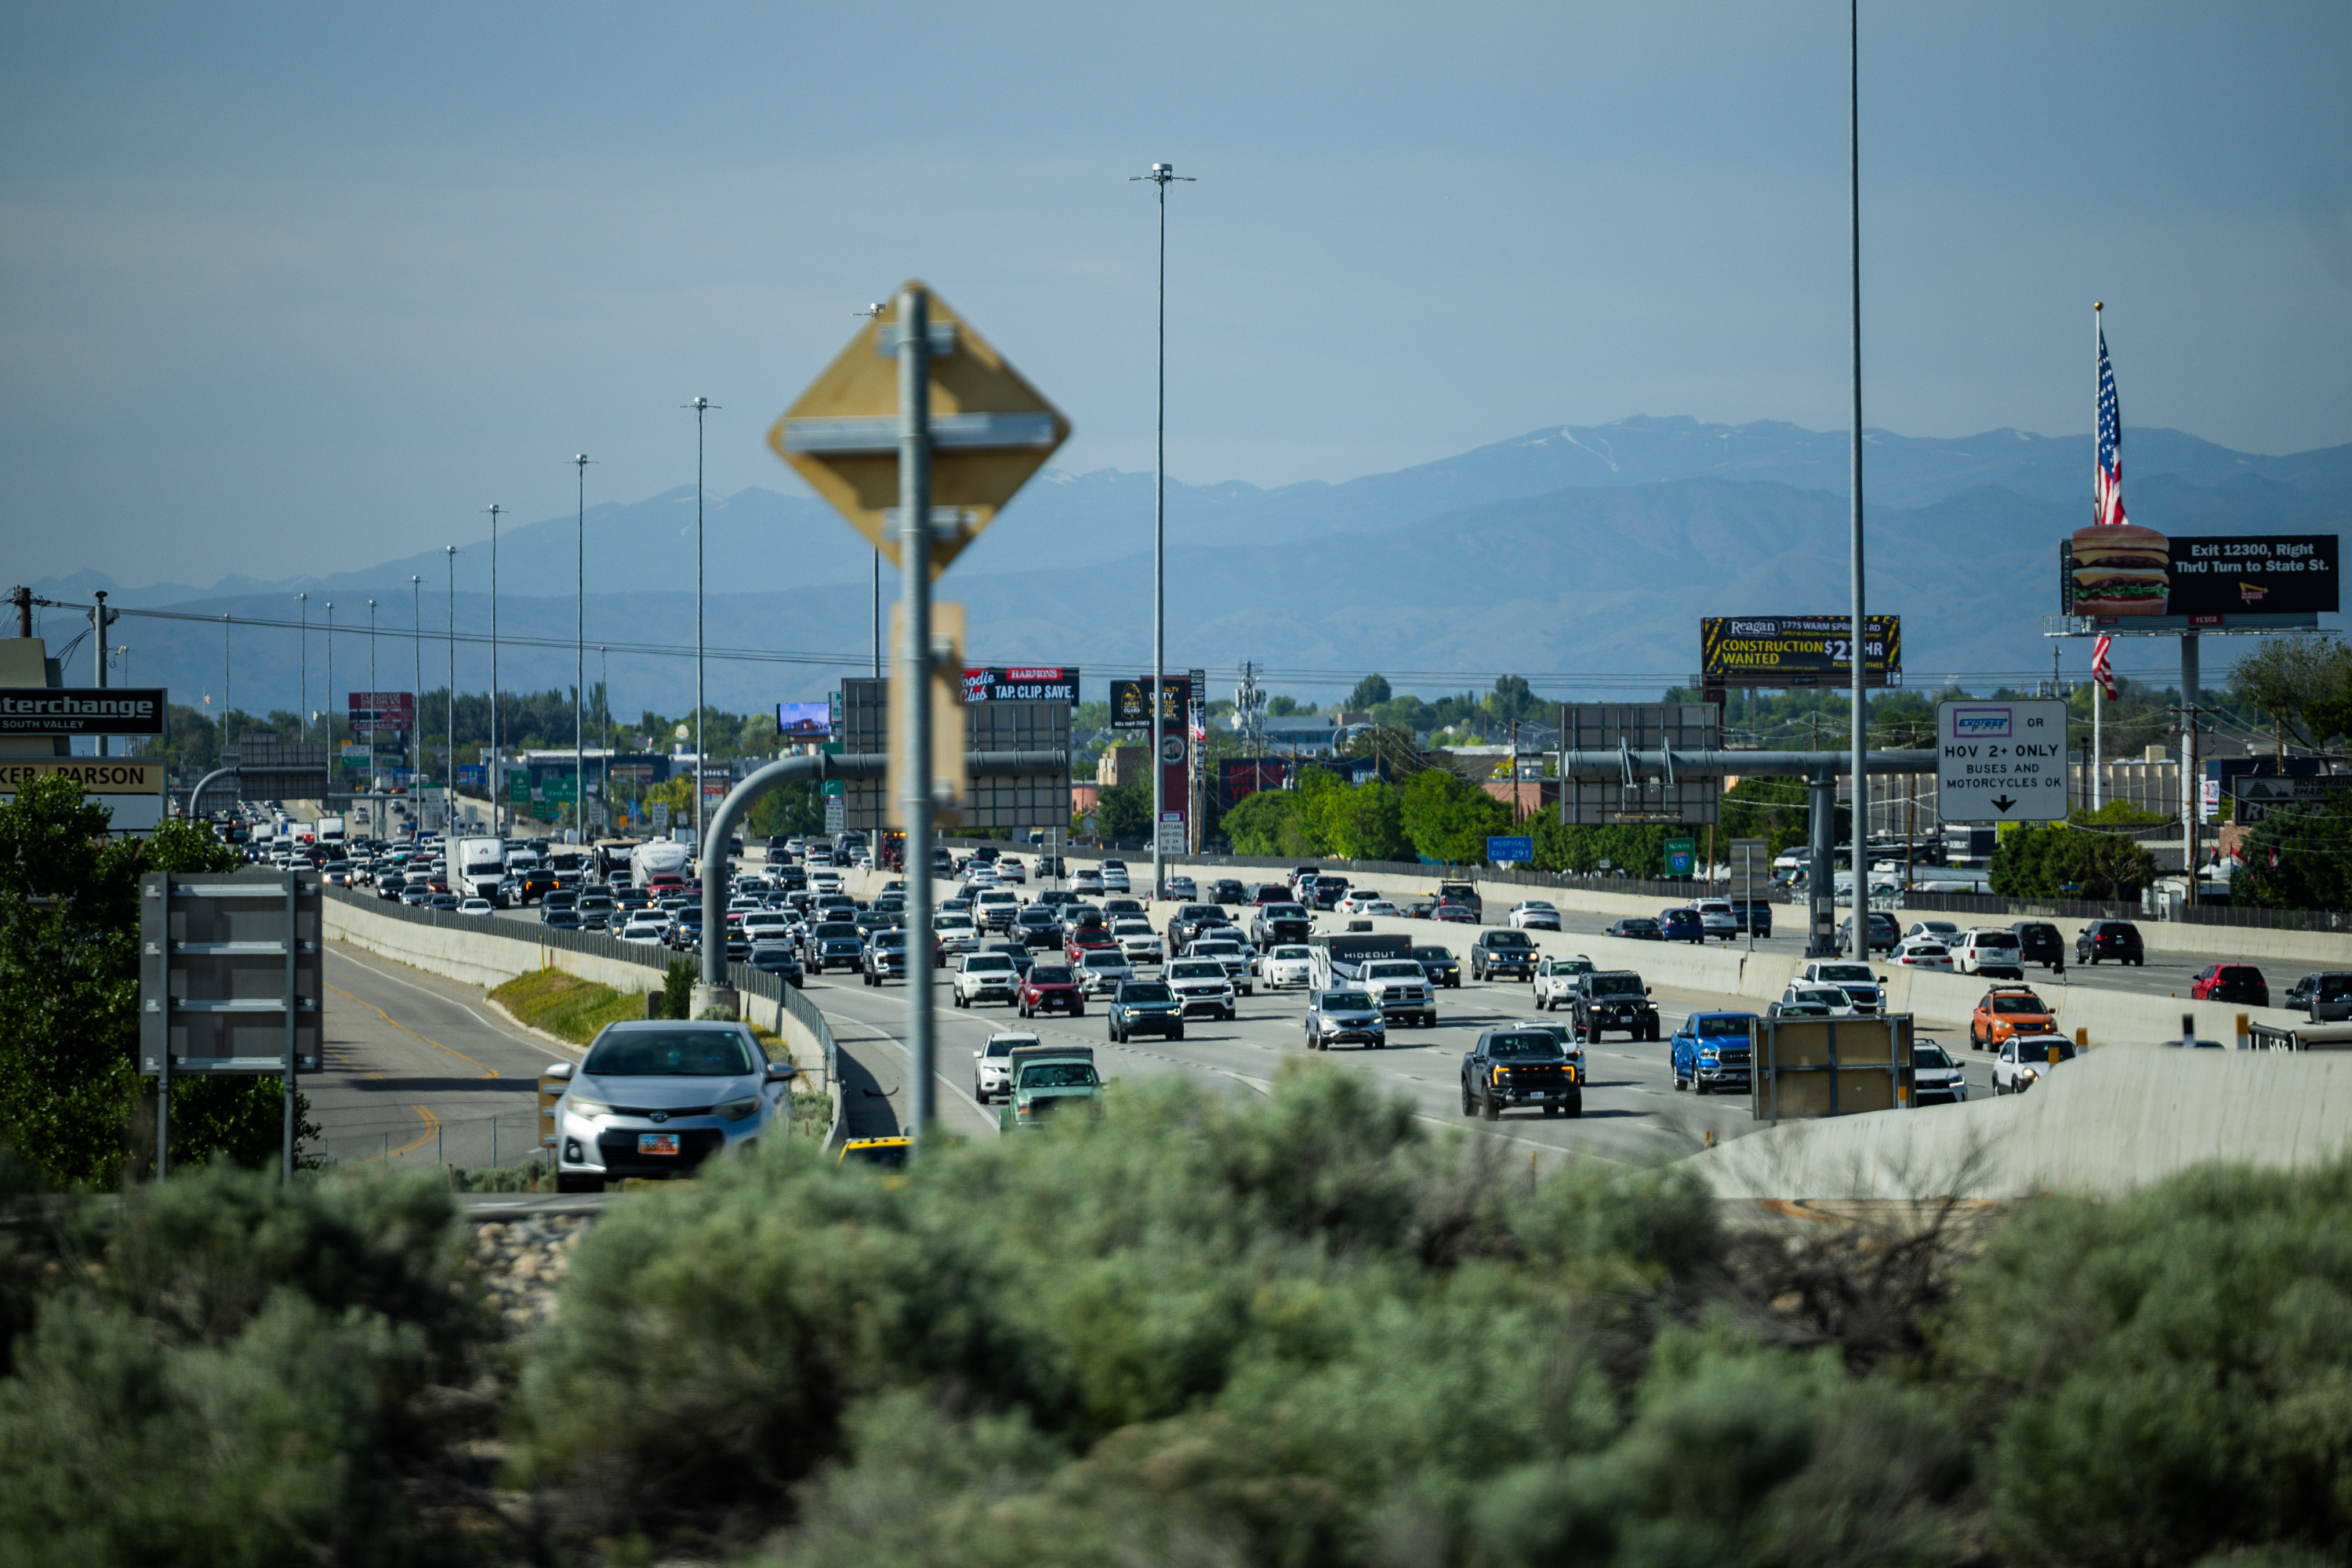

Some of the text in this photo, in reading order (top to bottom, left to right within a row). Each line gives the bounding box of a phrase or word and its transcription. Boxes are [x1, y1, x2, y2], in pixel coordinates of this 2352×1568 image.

[2191, 543, 2314, 558] Exit 12300, Right
[2176, 559, 2329, 573] ThrU Turn to State St.
[1731, 621, 1775, 634] Reagan
[1782, 621, 1802, 630] 1775
[1803, 622, 1830, 630] WARM
[1869, 623, 1881, 632] RD
[1722, 639, 1824, 652] CONSTRUCTION
[1722, 652, 1780, 665] WANTED
[961, 670, 995, 687] oodie
[1011, 670, 1058, 678] HARMONS
[995, 685, 1075, 699] TAP. CLIP. SAVE.
[0, 696, 154, 718] terchange
[2, 720, 85, 728] SOUTH VALLEY
[1958, 717, 2044, 733] Express OR
[1945, 744, 2059, 758] HOV 2+ ONLY
[1966, 763, 2039, 774] BUSES AND
[57, 767, 144, 785] PARSON
[1947, 777, 2062, 789] MOTORCYCLES OK
[1512, 849, 1529, 858] 291
[1675, 858, 1686, 866] 15
[1344, 950, 1396, 959] HIDEOUT
